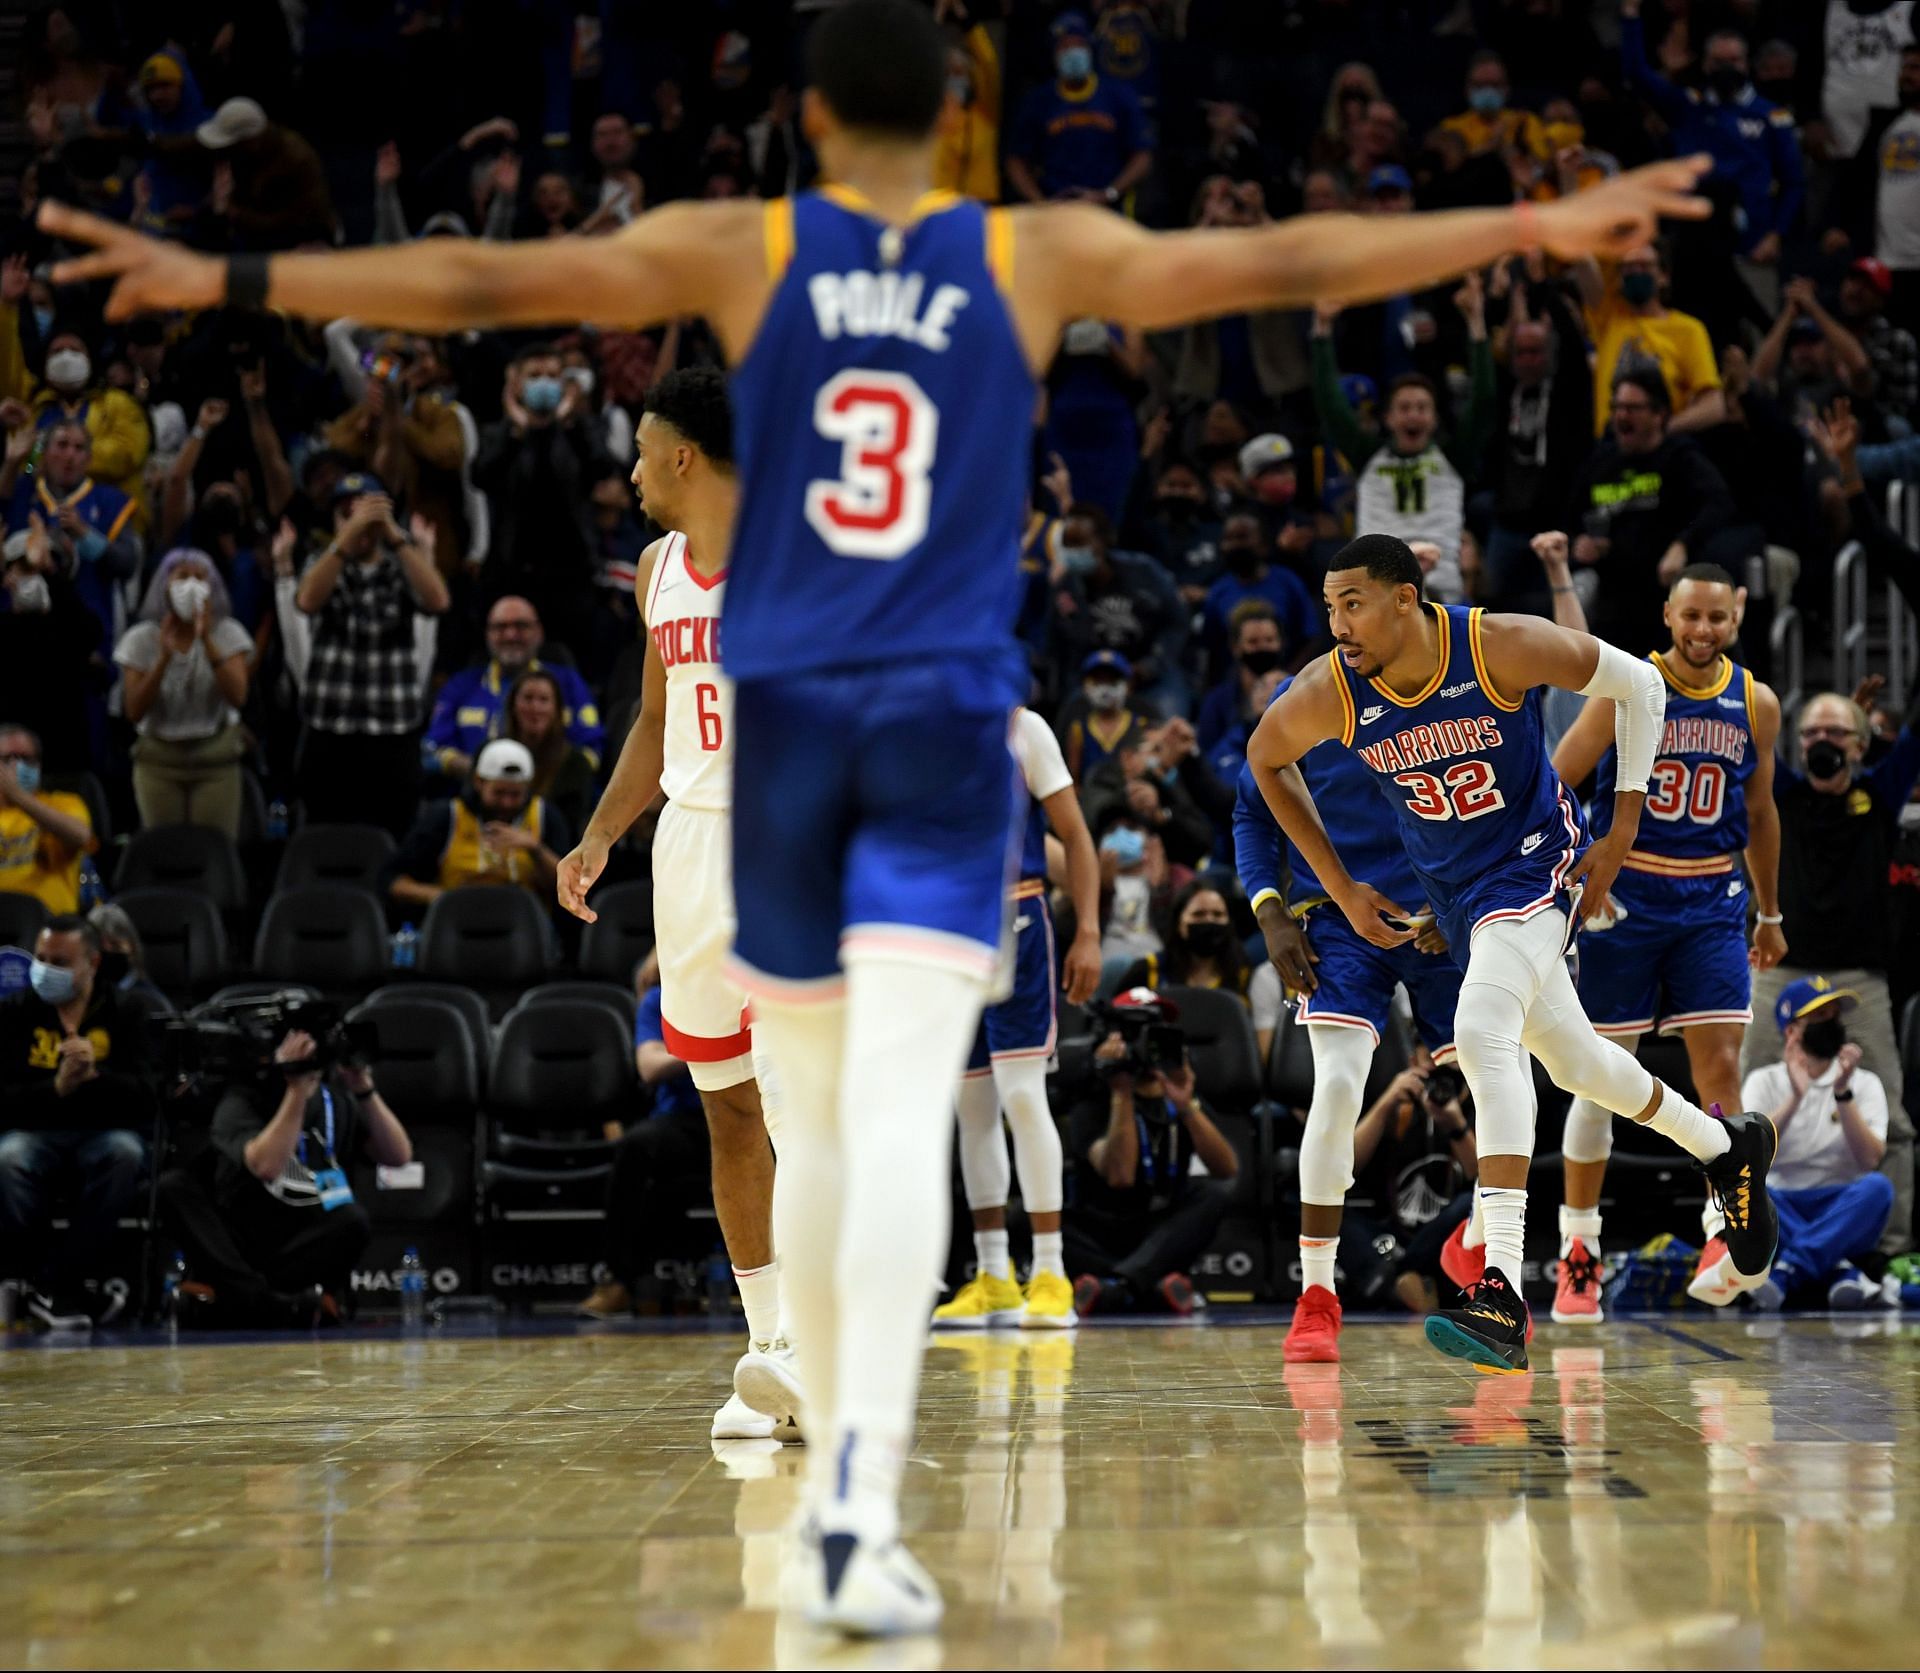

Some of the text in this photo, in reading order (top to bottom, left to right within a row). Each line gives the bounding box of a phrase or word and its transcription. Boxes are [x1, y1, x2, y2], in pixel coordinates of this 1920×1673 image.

[808, 270, 970, 351] POOLE
[804, 368, 939, 560] 3
[695, 683, 722, 751] 6
[1363, 705, 1383, 719] NIKE
[1440, 681, 1477, 698] Rakuten
[1358, 716, 1503, 773] WARRIORS
[1655, 718, 1748, 765] ARRIORS
[1393, 760, 1506, 822] 32
[1645, 759, 1726, 825] 30
[1523, 832, 1542, 849] NIKE
[492, 1264, 588, 1285] CHASE
